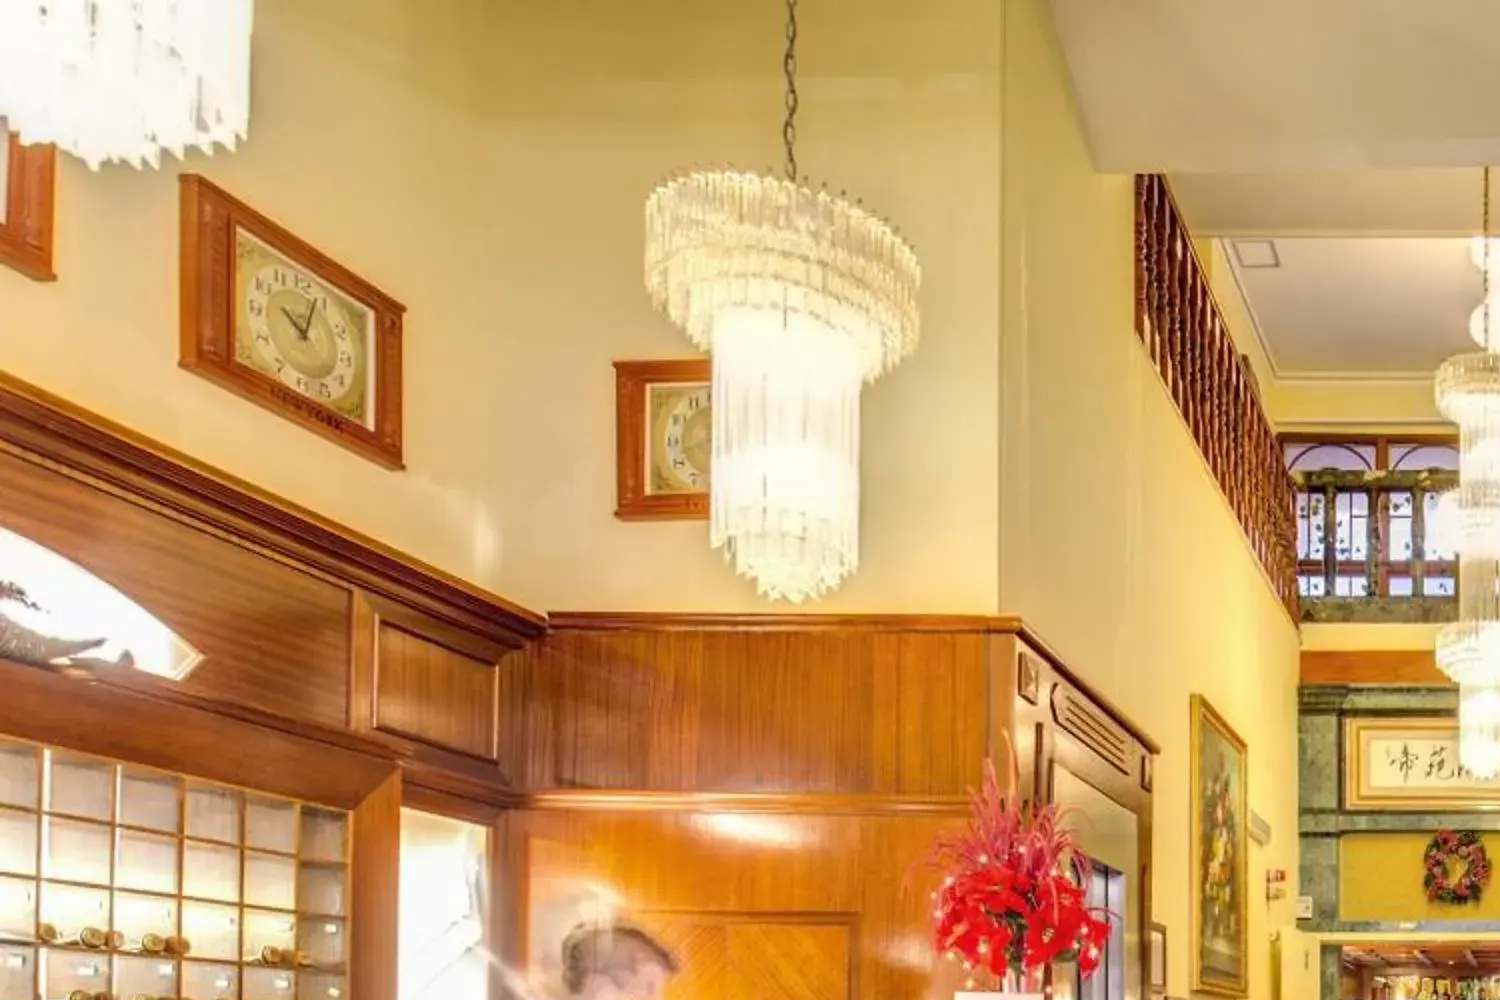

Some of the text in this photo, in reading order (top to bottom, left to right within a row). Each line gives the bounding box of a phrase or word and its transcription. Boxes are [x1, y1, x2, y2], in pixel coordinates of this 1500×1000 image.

[254, 276, 272, 295] 10
[273, 268, 286, 286] 11
[294, 274, 313, 295] 12
[334, 323, 347, 341] 2
[688, 395, 699, 410] 11
[306, 405, 344, 433] YORK
